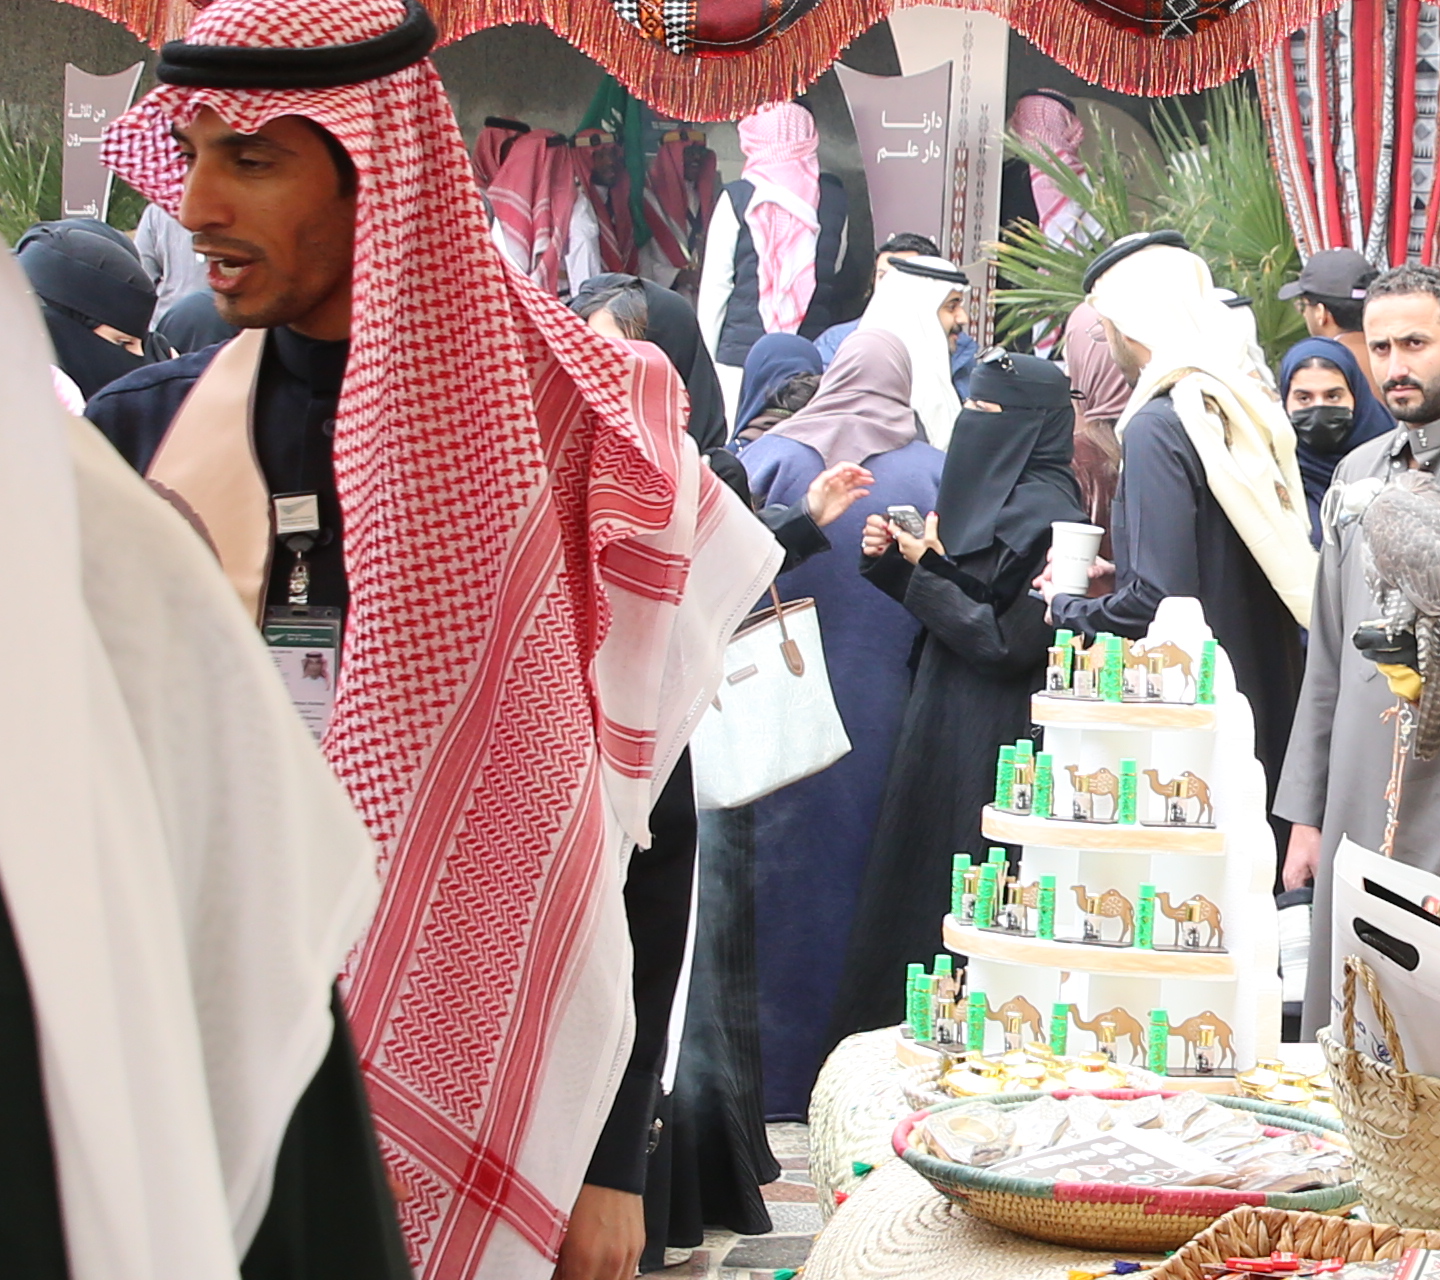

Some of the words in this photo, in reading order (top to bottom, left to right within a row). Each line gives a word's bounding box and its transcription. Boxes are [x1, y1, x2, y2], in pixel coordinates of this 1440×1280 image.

[67, 102, 92, 118] ثلاثة
[93, 108, 106, 122] من
[881, 109, 943, 134] دارنا
[876, 139, 920, 164] علم
[921, 140, 941, 164] دار
